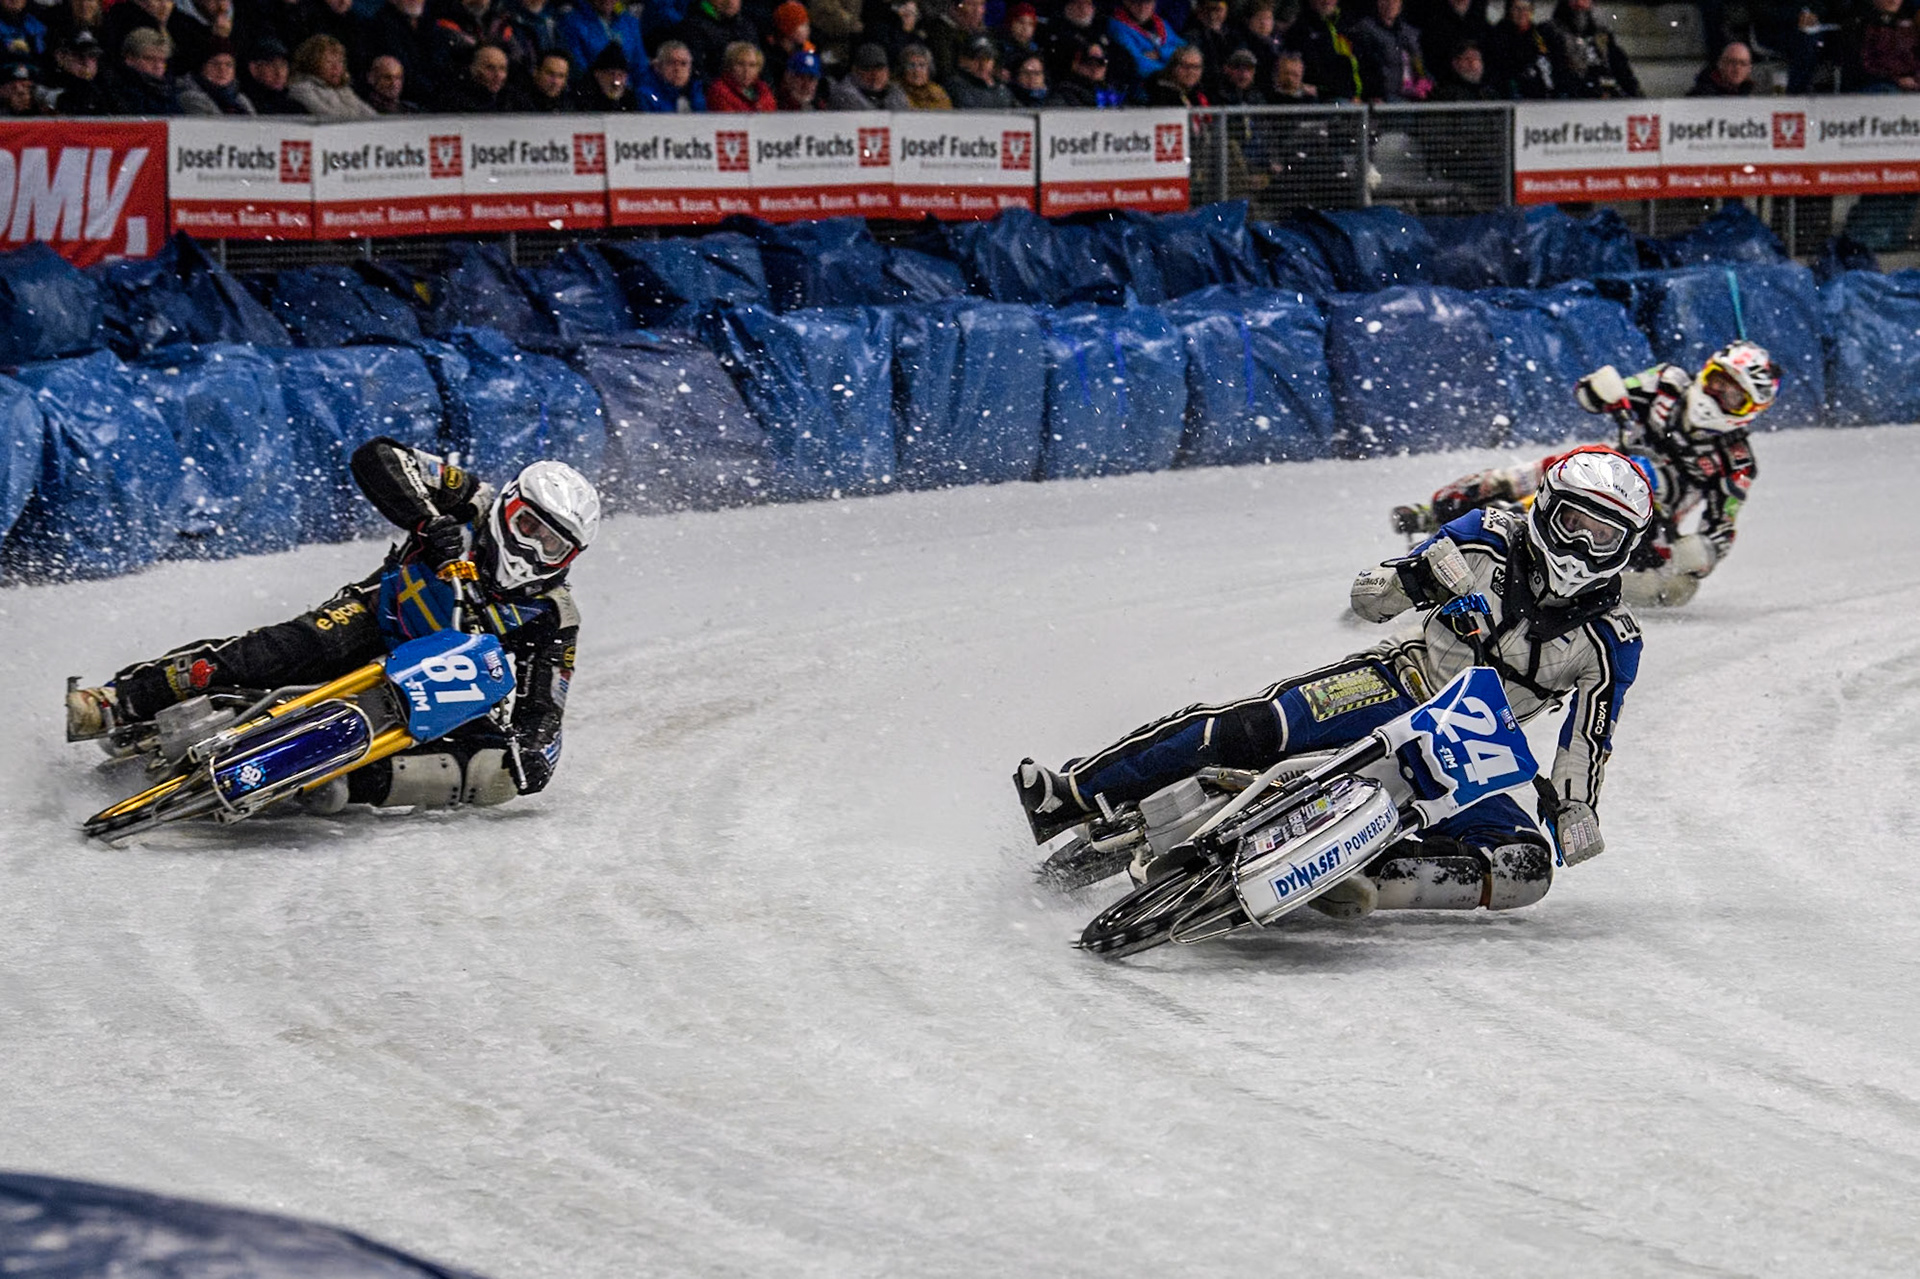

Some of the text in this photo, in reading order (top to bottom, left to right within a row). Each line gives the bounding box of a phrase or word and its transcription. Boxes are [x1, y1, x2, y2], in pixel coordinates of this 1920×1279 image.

[1523, 121, 1622, 150] Josef Fuchs
[1668, 117, 1768, 145] Josef Fuchs
[1819, 116, 1866, 142] Josef
[177, 143, 276, 173] Josef Fuchs
[322, 142, 425, 175] Josef Fuchs
[471, 138, 569, 169] Josef Fuchs
[615, 135, 713, 164] Josef Fuchs
[757, 133, 854, 163] Josef Fuchs
[901, 134, 997, 161] Josef Fuchs
[1049, 130, 1151, 159] Josef Fuchs
[0, 147, 149, 255] MV.
[404, 677, 432, 711] FIM
[420, 654, 486, 704] 81
[1594, 701, 1608, 735] WACO
[1426, 696, 1520, 785] 24
[1438, 744, 1458, 769] FIM
[1275, 846, 1342, 897] DYNASET
[1344, 814, 1387, 856] POWERED
